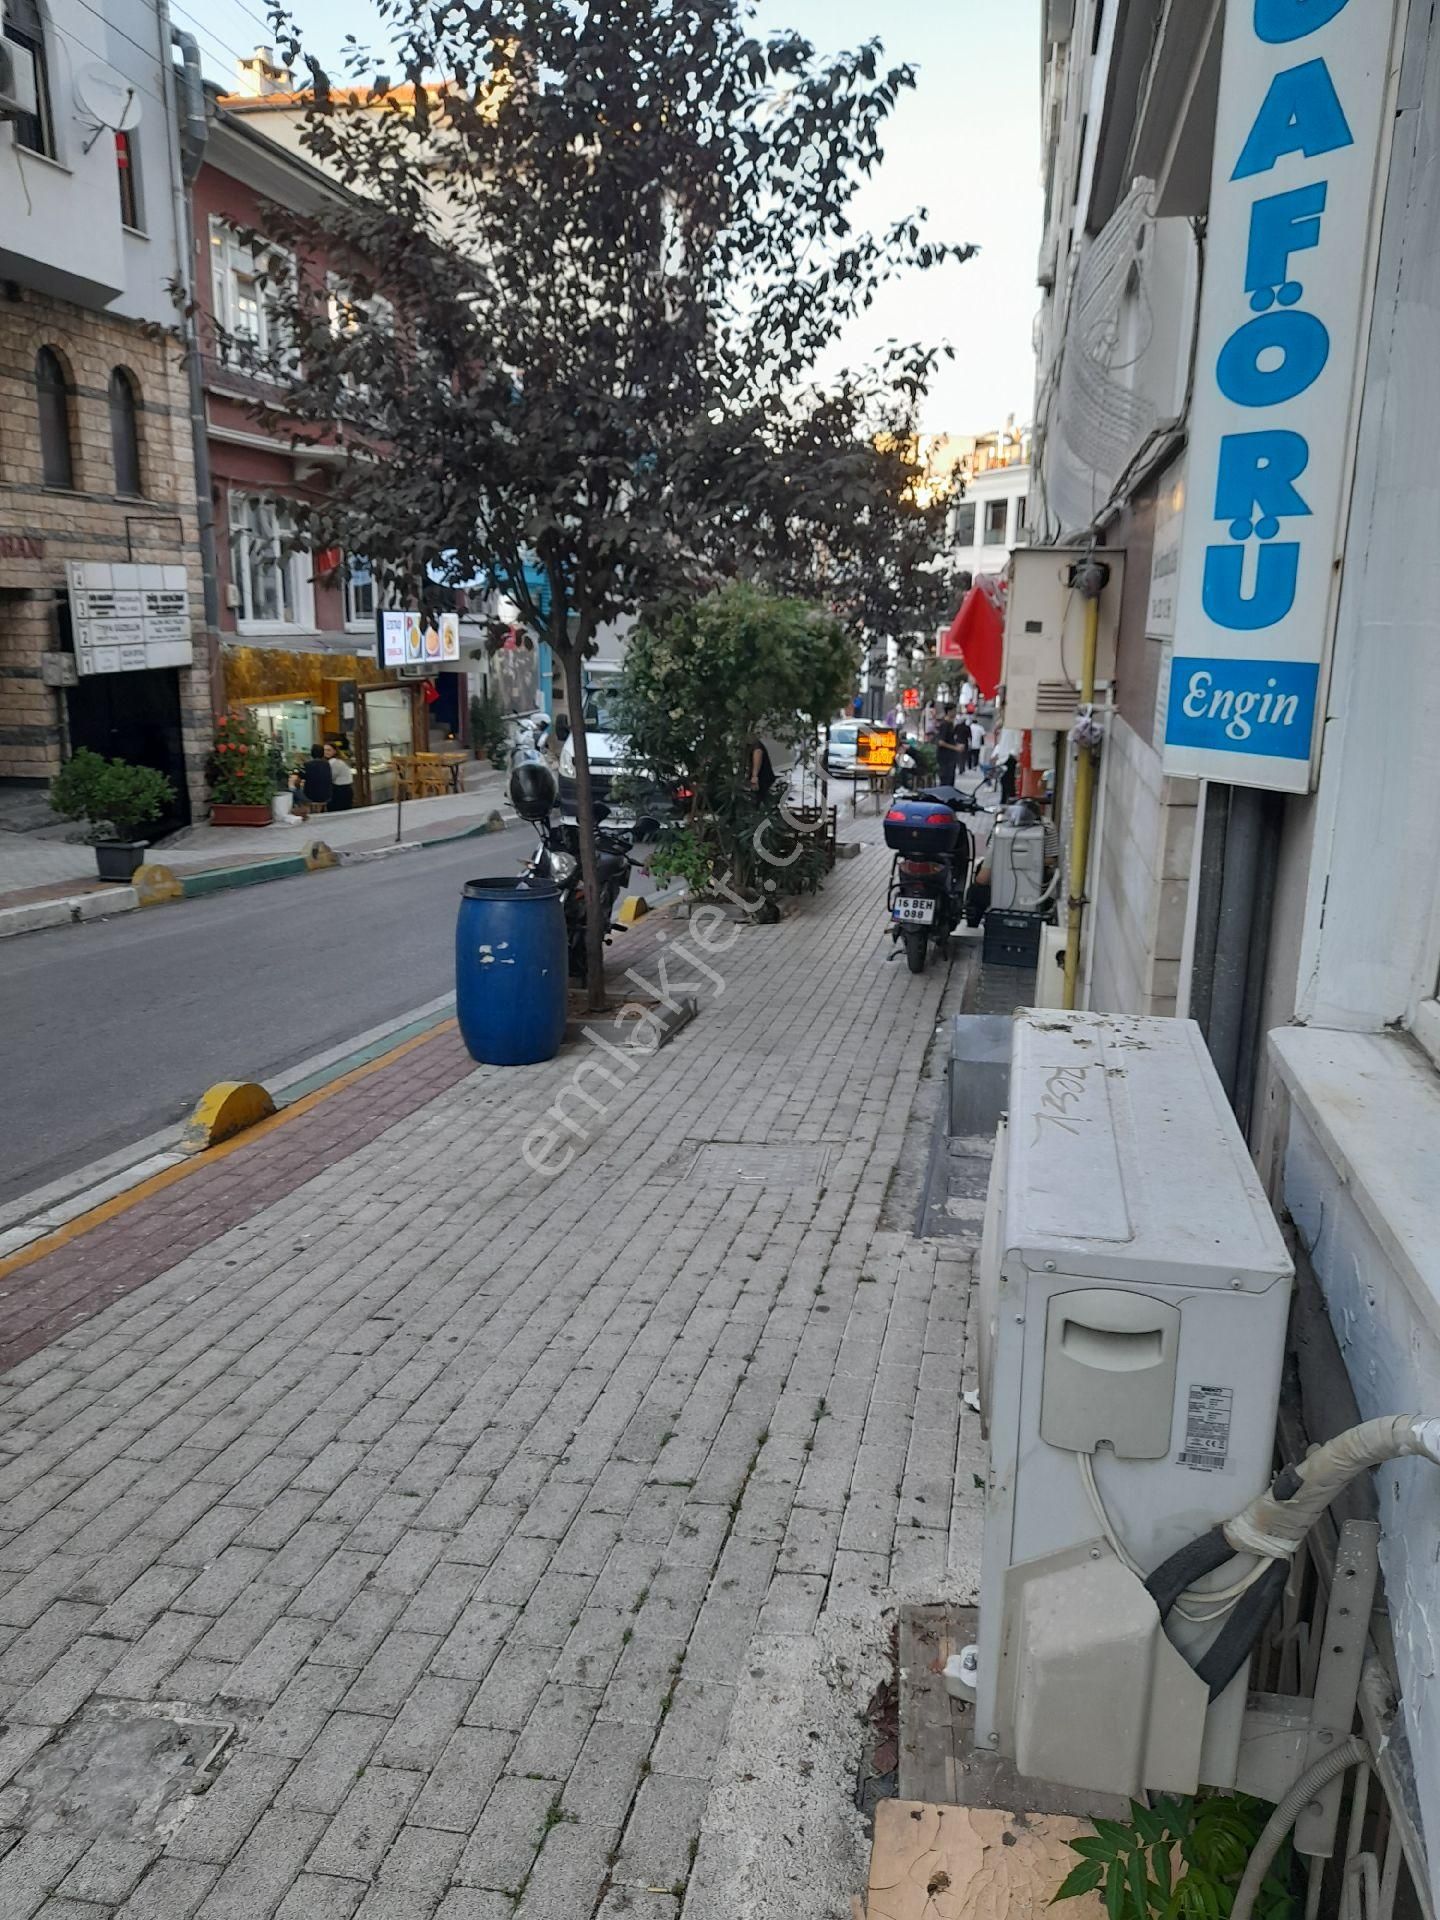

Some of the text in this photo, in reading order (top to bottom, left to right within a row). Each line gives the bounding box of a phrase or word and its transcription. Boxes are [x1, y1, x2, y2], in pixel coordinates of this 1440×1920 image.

[1183, 671, 1299, 740] Engin
[898, 899, 933, 910] 16 BEH
